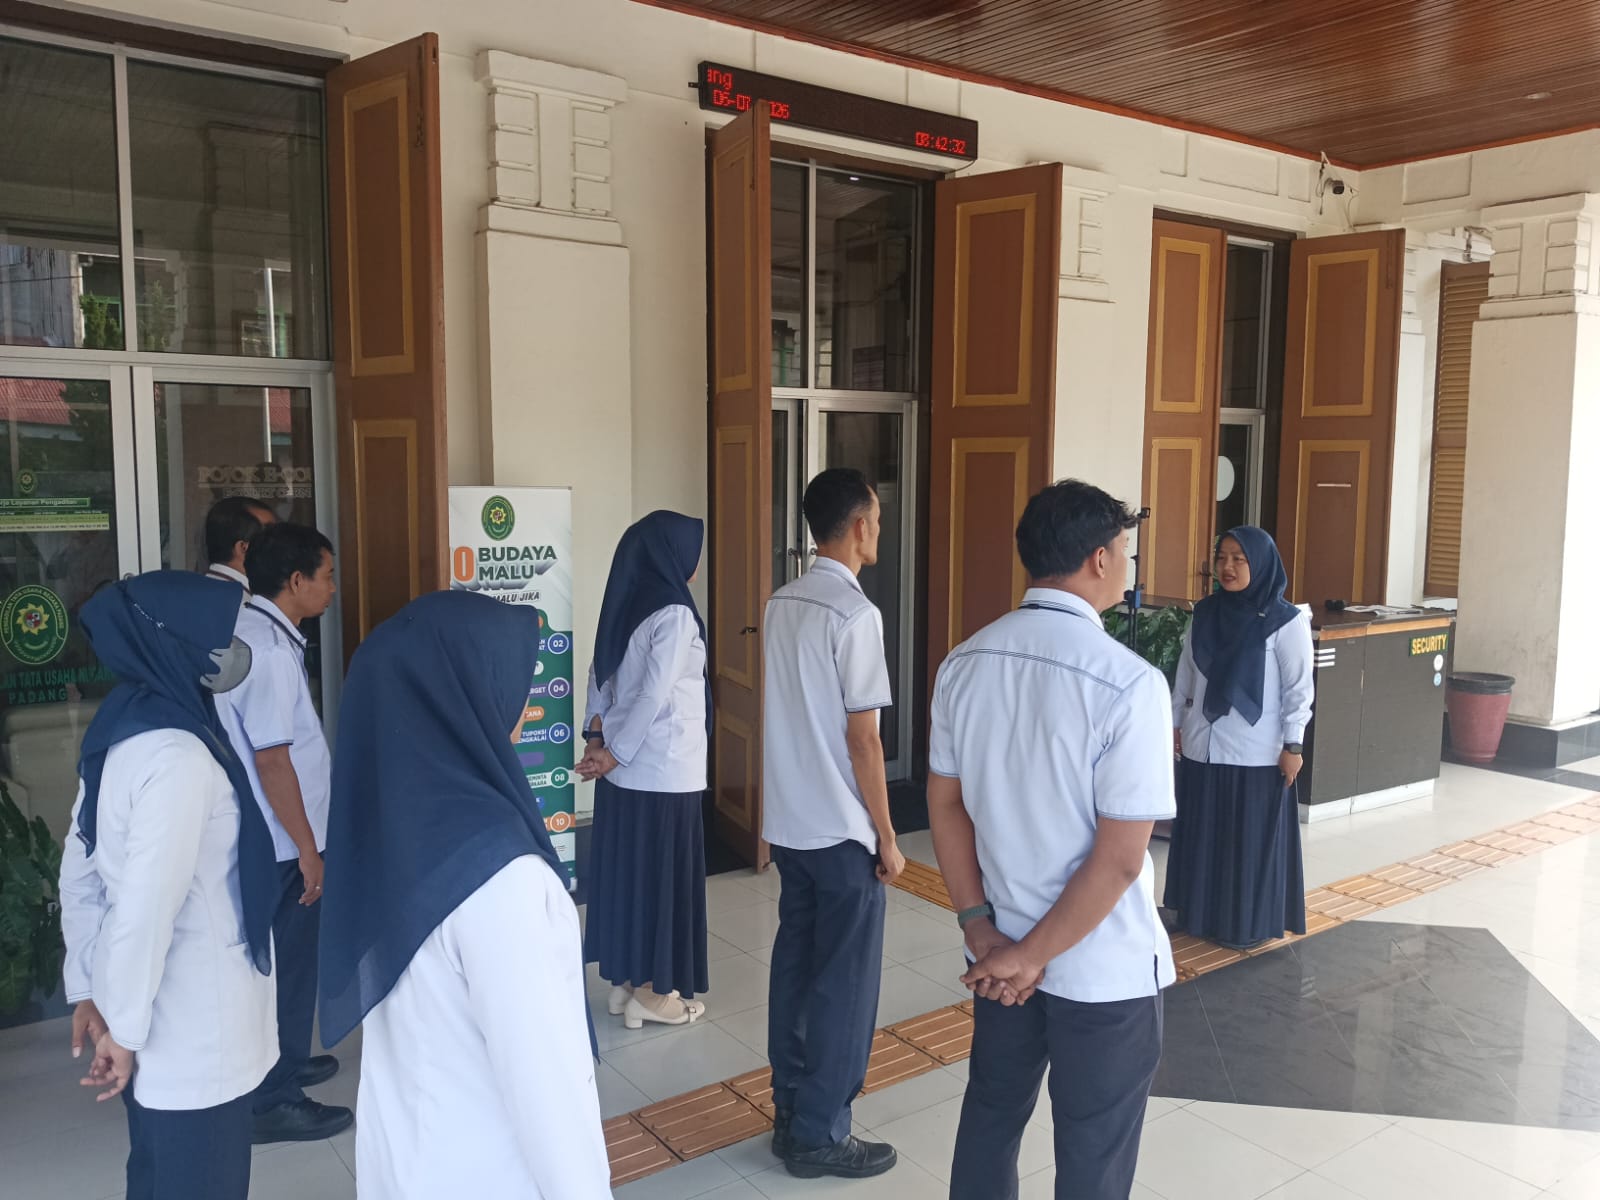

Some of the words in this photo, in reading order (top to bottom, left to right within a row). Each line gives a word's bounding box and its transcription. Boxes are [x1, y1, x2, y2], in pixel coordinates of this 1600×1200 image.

[478, 546, 557, 562] BUDAYA
[479, 565, 534, 581] MALU
[519, 591, 540, 602] JIKA
[553, 639, 564, 648] 02
[1411, 634, 1447, 655] SECURITY
[45, 668, 76, 685] USAHA
[553, 684, 564, 693] 04
[9, 688, 67, 704] PADANG
[554, 729, 565, 737] 06
[519, 735, 547, 743] NGKALAI
[556, 817, 565, 826] 10
